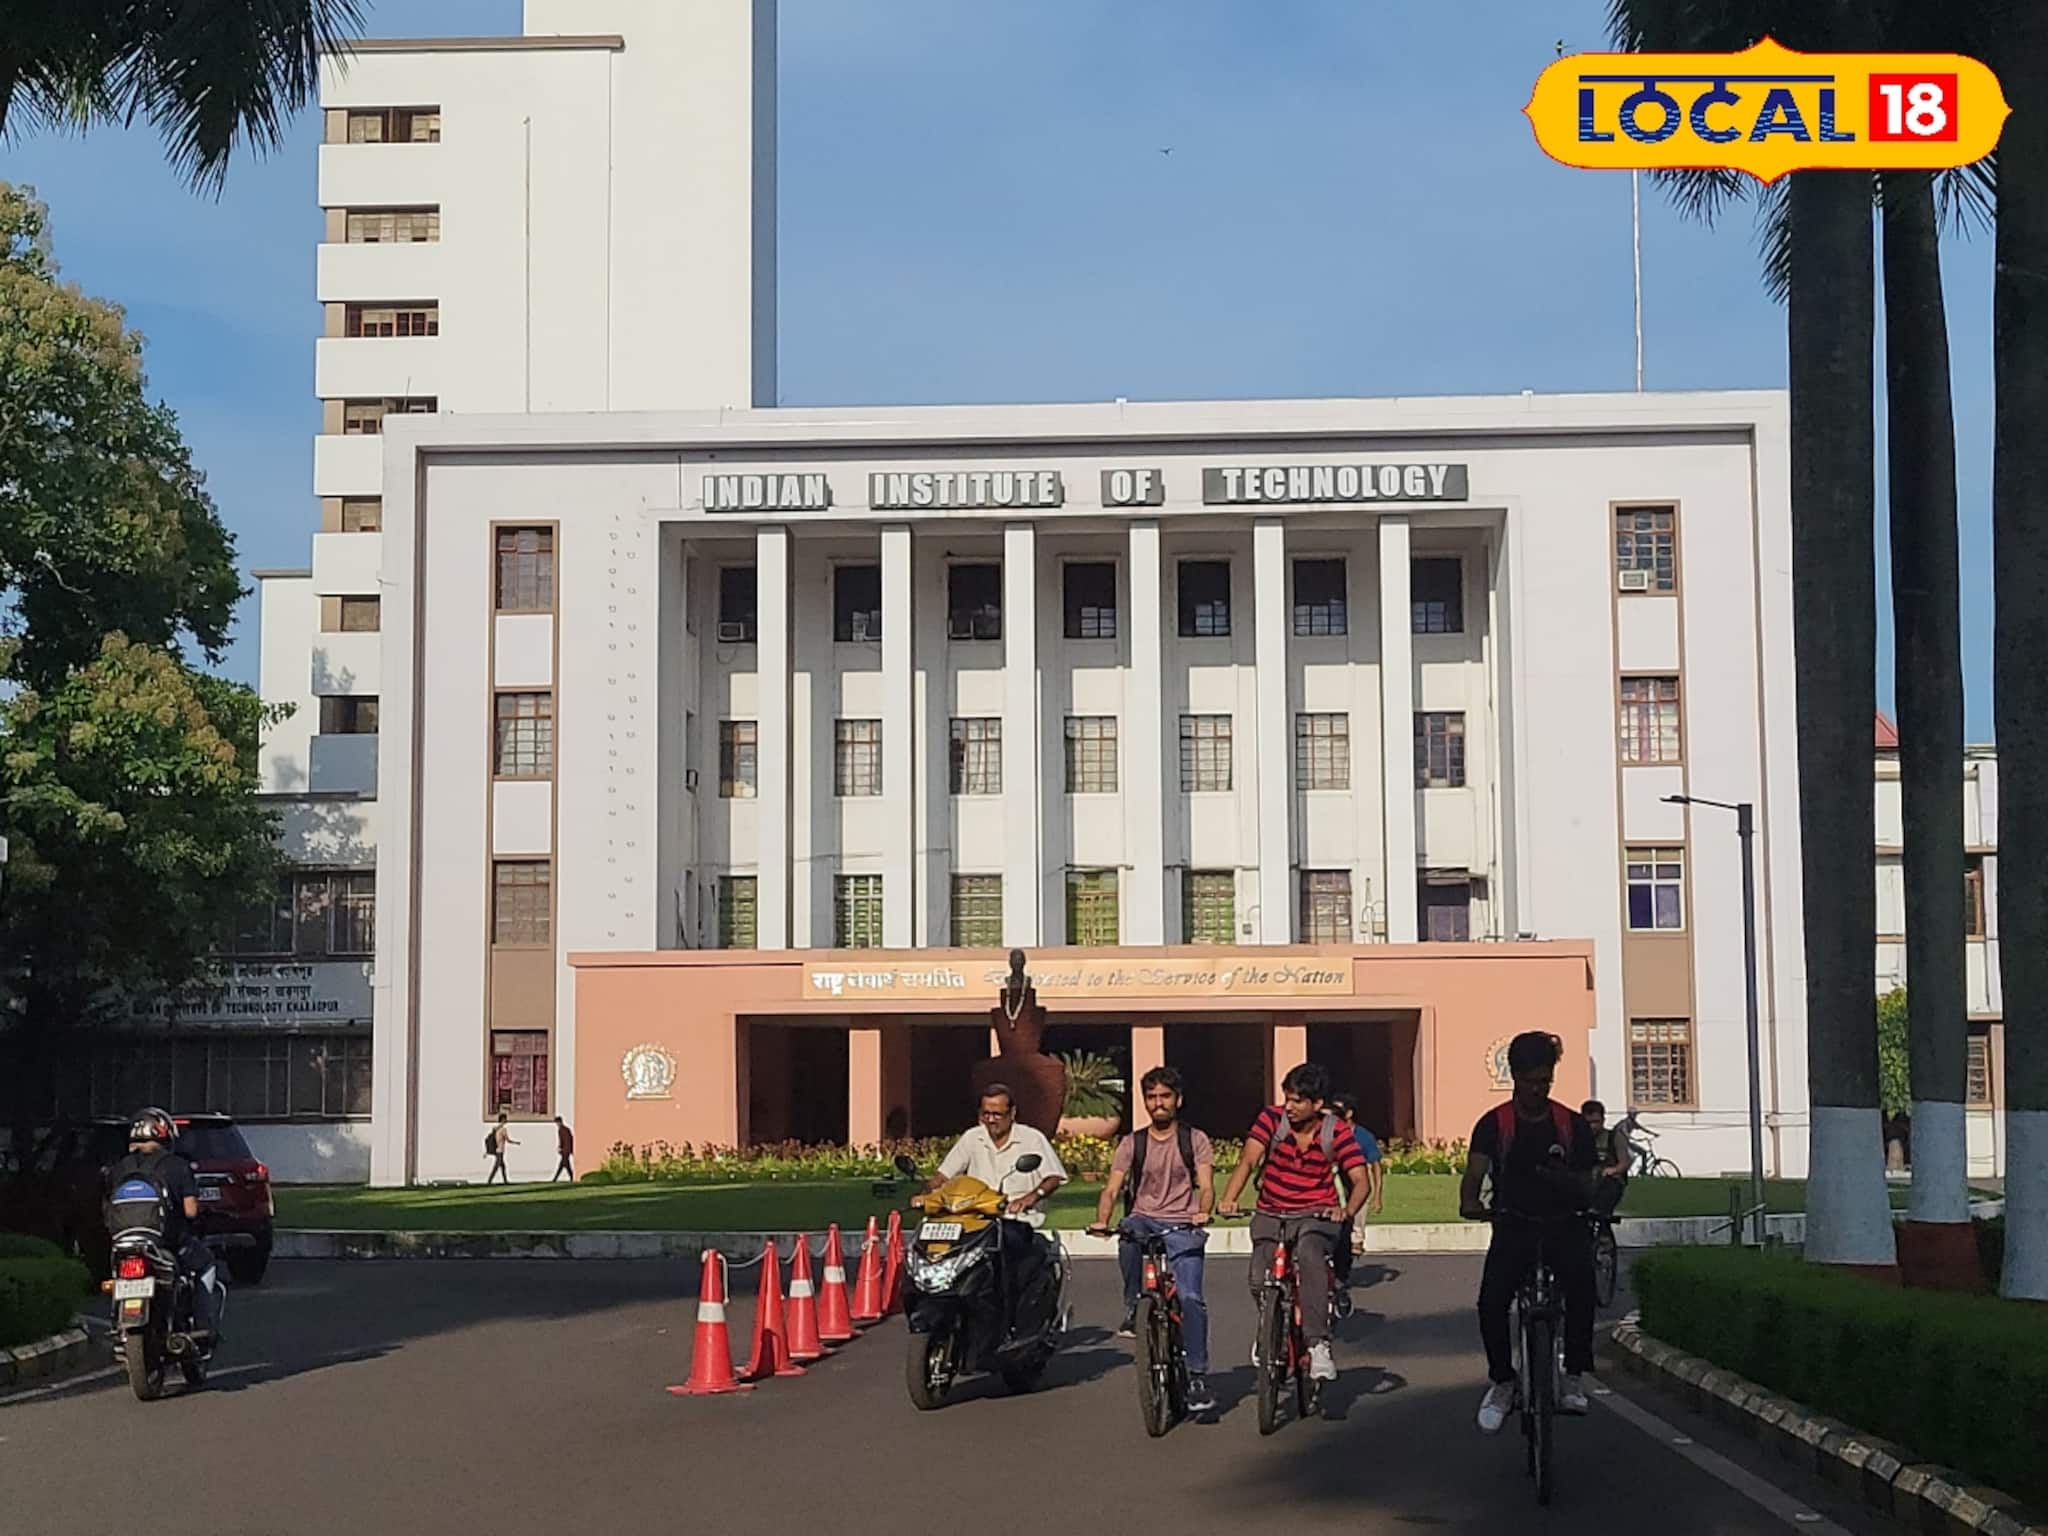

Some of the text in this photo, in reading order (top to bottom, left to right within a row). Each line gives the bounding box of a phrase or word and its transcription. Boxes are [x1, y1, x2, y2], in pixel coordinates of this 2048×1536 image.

[703, 465, 1448, 508] INDIAN INSTITUTE OF TECHNOLOGY
[1087, 970, 1103, 986] to
[1107, 969, 1131, 986] the
[1136, 967, 1216, 986] Service
[1220, 967, 1243, 990] of
[1244, 966, 1268, 985] the
[1273, 963, 1345, 984] Nation
[226, 1001, 283, 1014] TECHNOLOGY
[287, 1000, 338, 1012] KHARAGPUR
